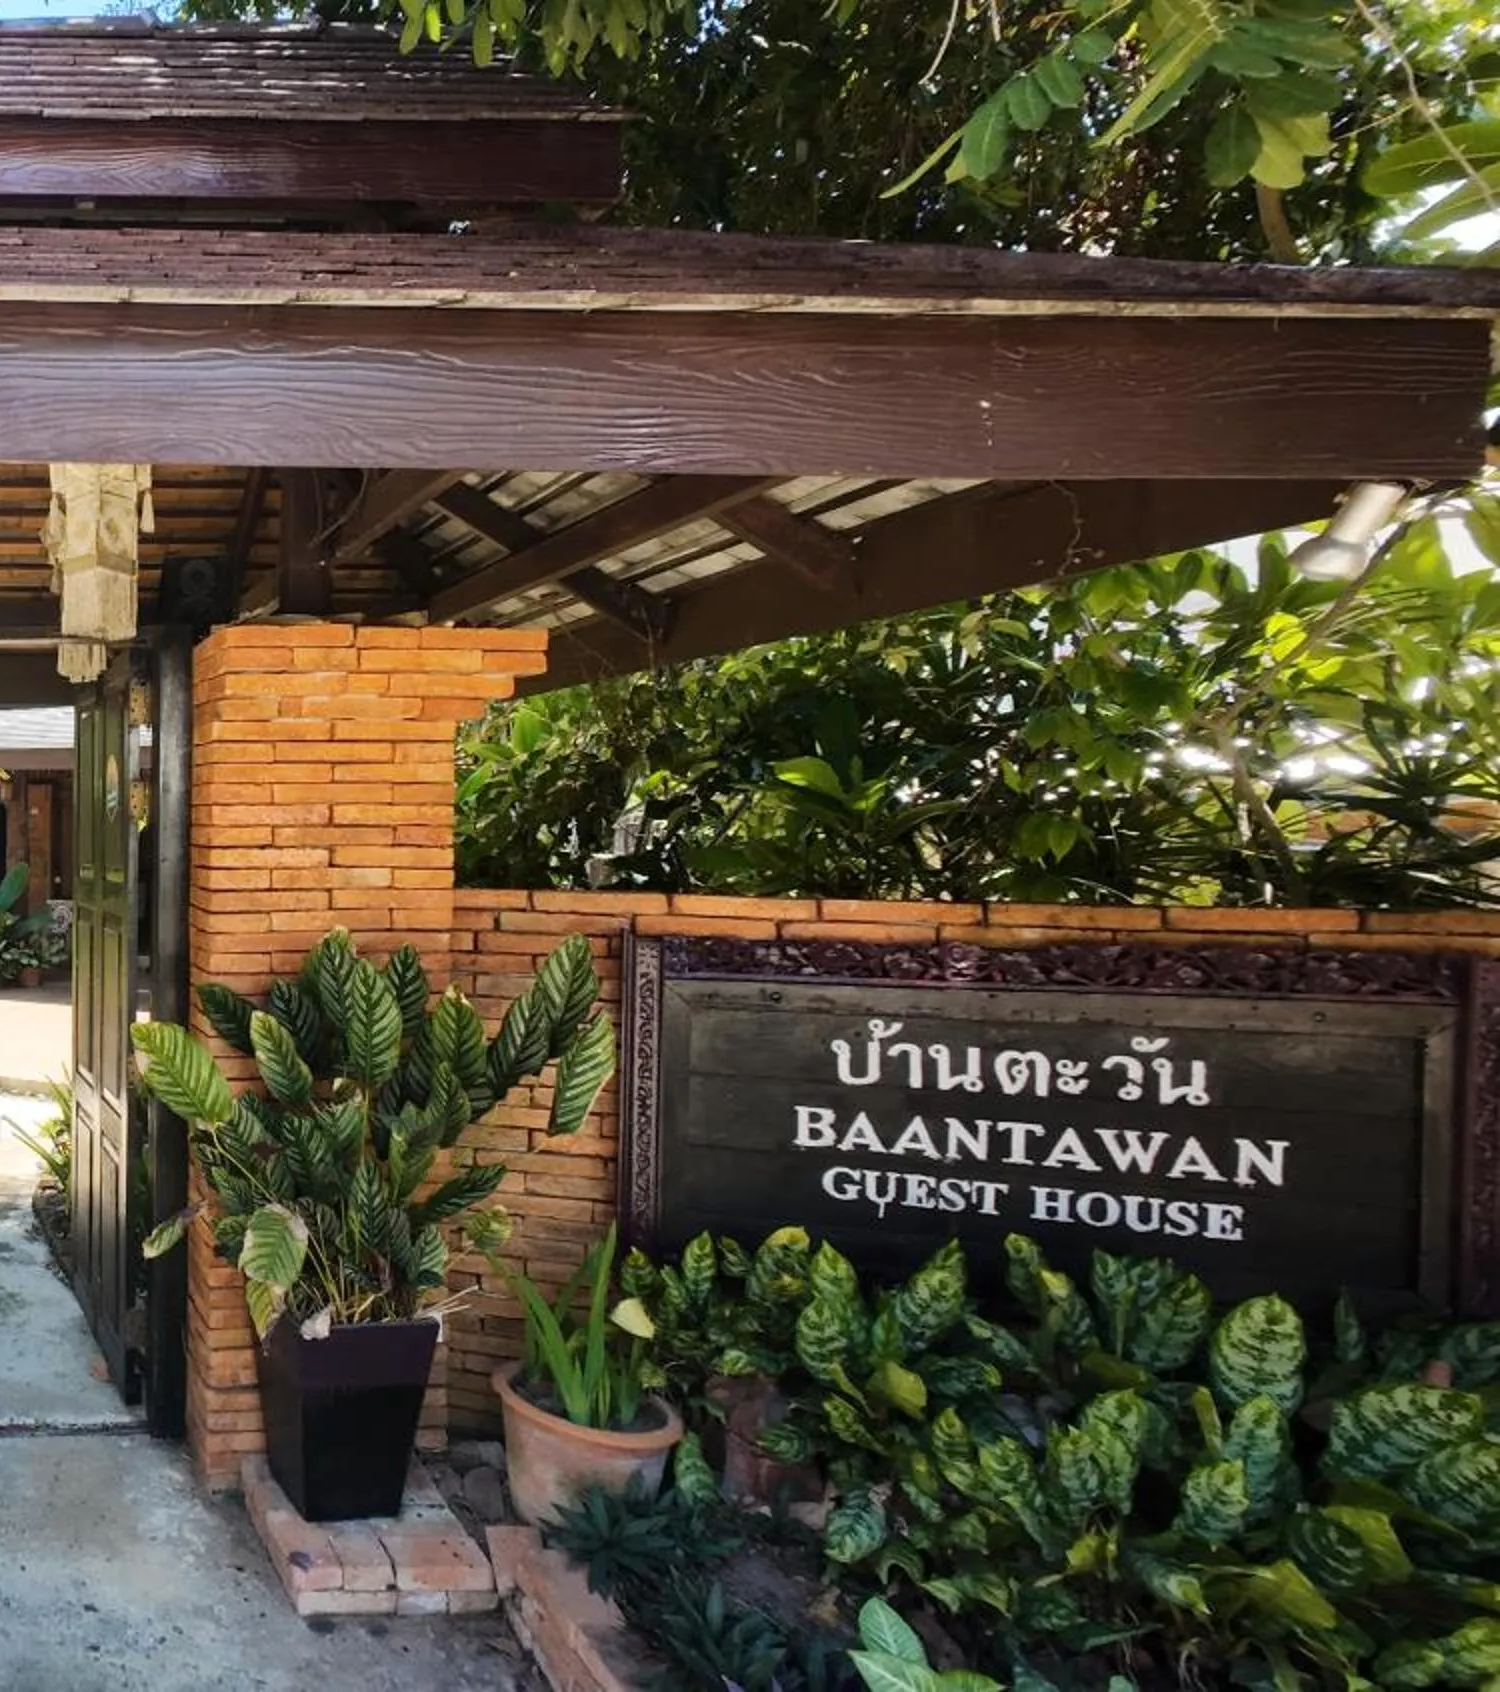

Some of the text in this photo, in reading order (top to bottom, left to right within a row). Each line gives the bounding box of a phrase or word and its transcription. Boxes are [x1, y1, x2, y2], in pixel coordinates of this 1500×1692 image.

[831, 1018, 1211, 1106] บ้านตะวัน
[792, 1104, 1292, 1188] BAANTAWAN
[820, 1165, 1246, 1242] GUEST HOUSE
